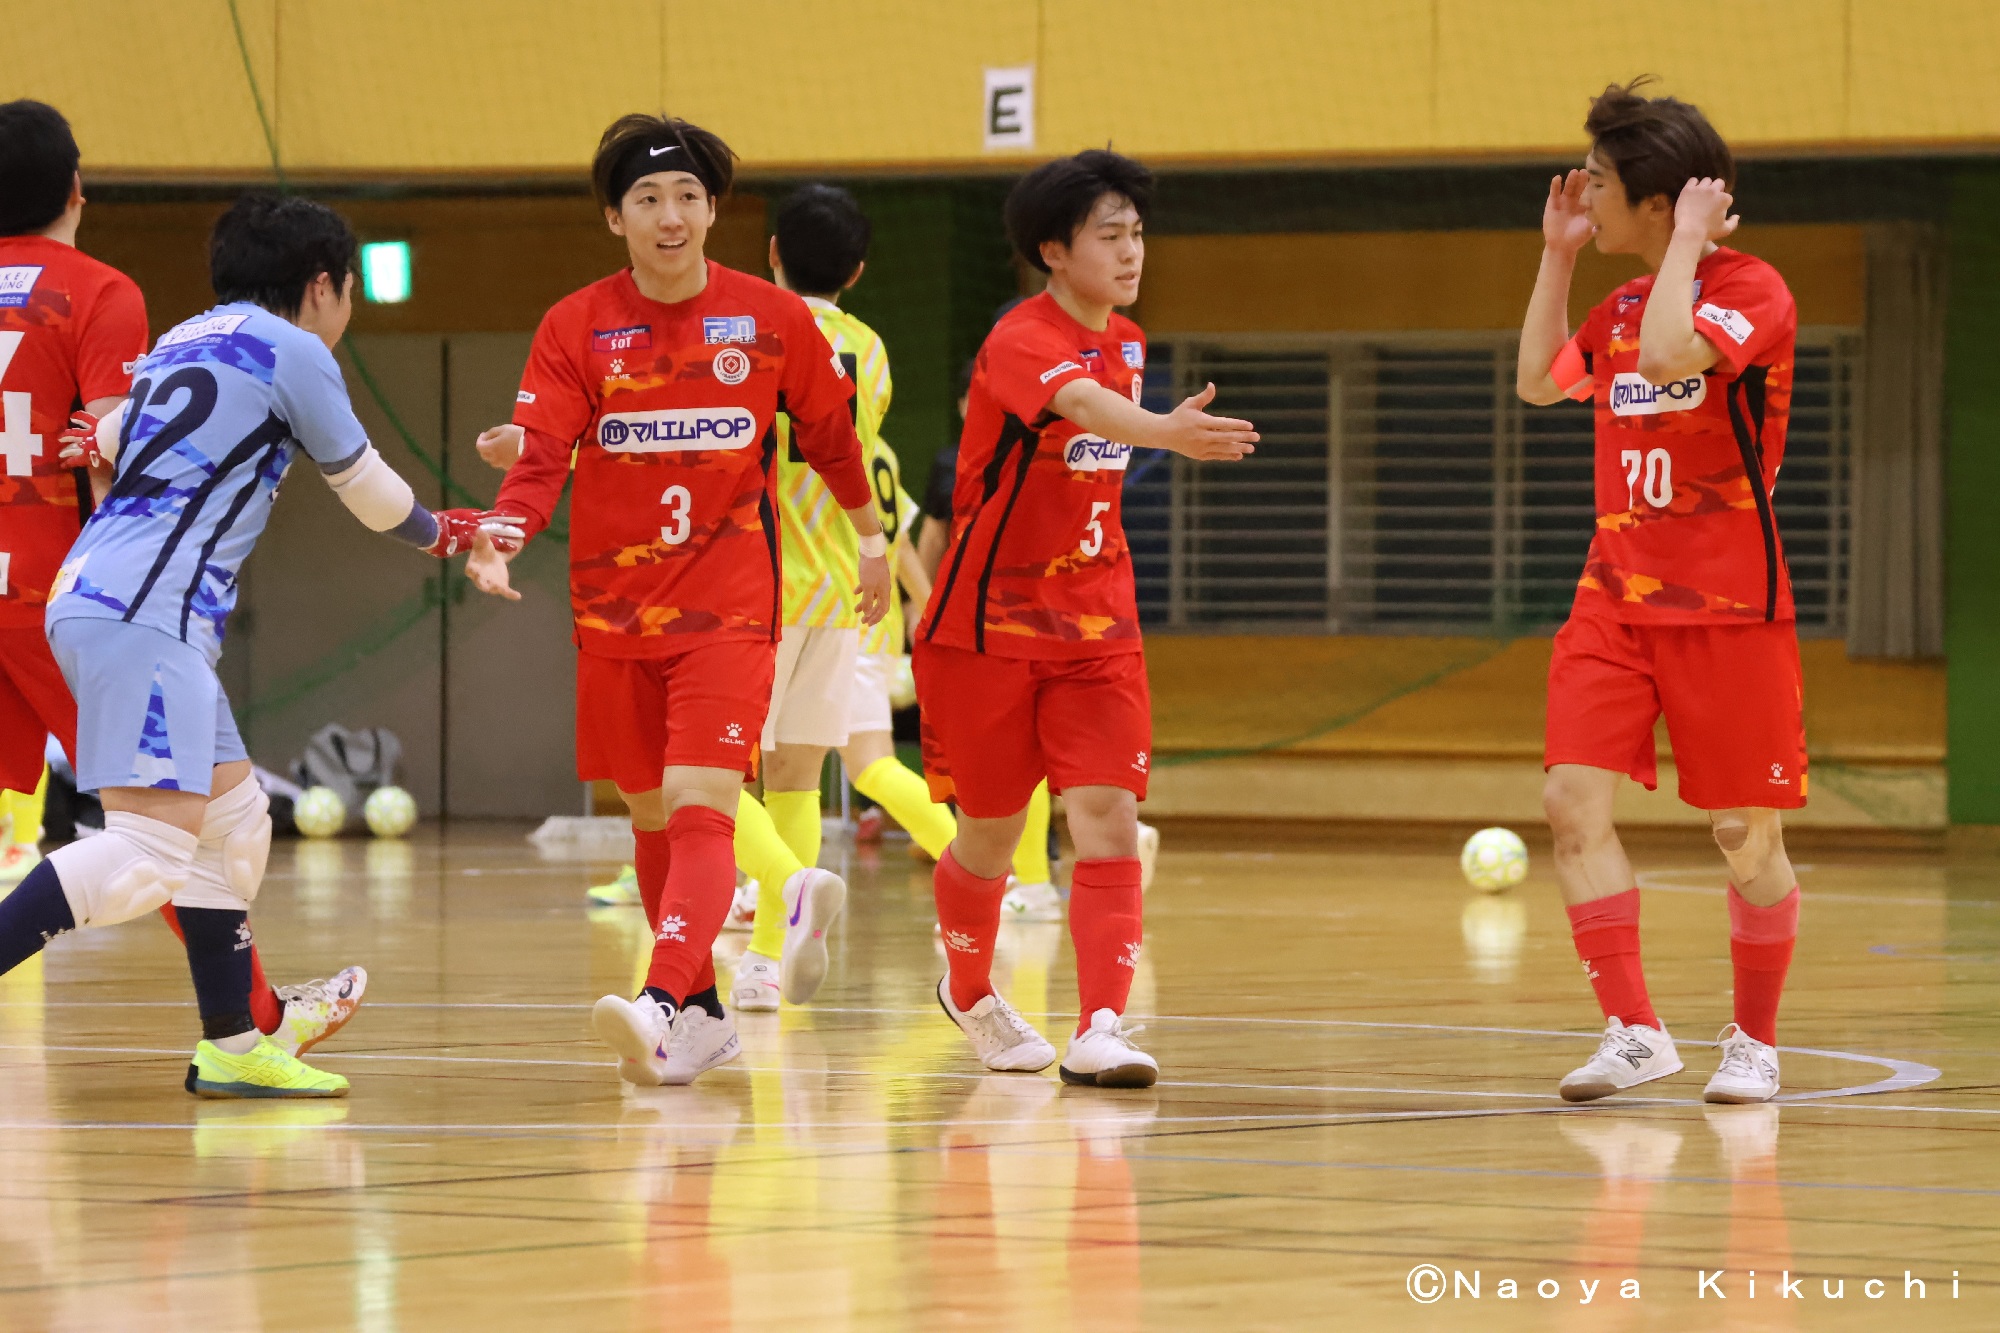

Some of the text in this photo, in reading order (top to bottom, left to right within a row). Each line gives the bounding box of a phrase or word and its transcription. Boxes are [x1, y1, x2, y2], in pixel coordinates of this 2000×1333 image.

[991, 86, 1023, 134] E
[611, 337, 632, 350] SOT
[112, 366, 218, 498] 12
[1621, 447, 1673, 510] 70
[660, 484, 691, 545] 3
[1080, 501, 1111, 557] 5
[718, 737, 746, 746] KELME
